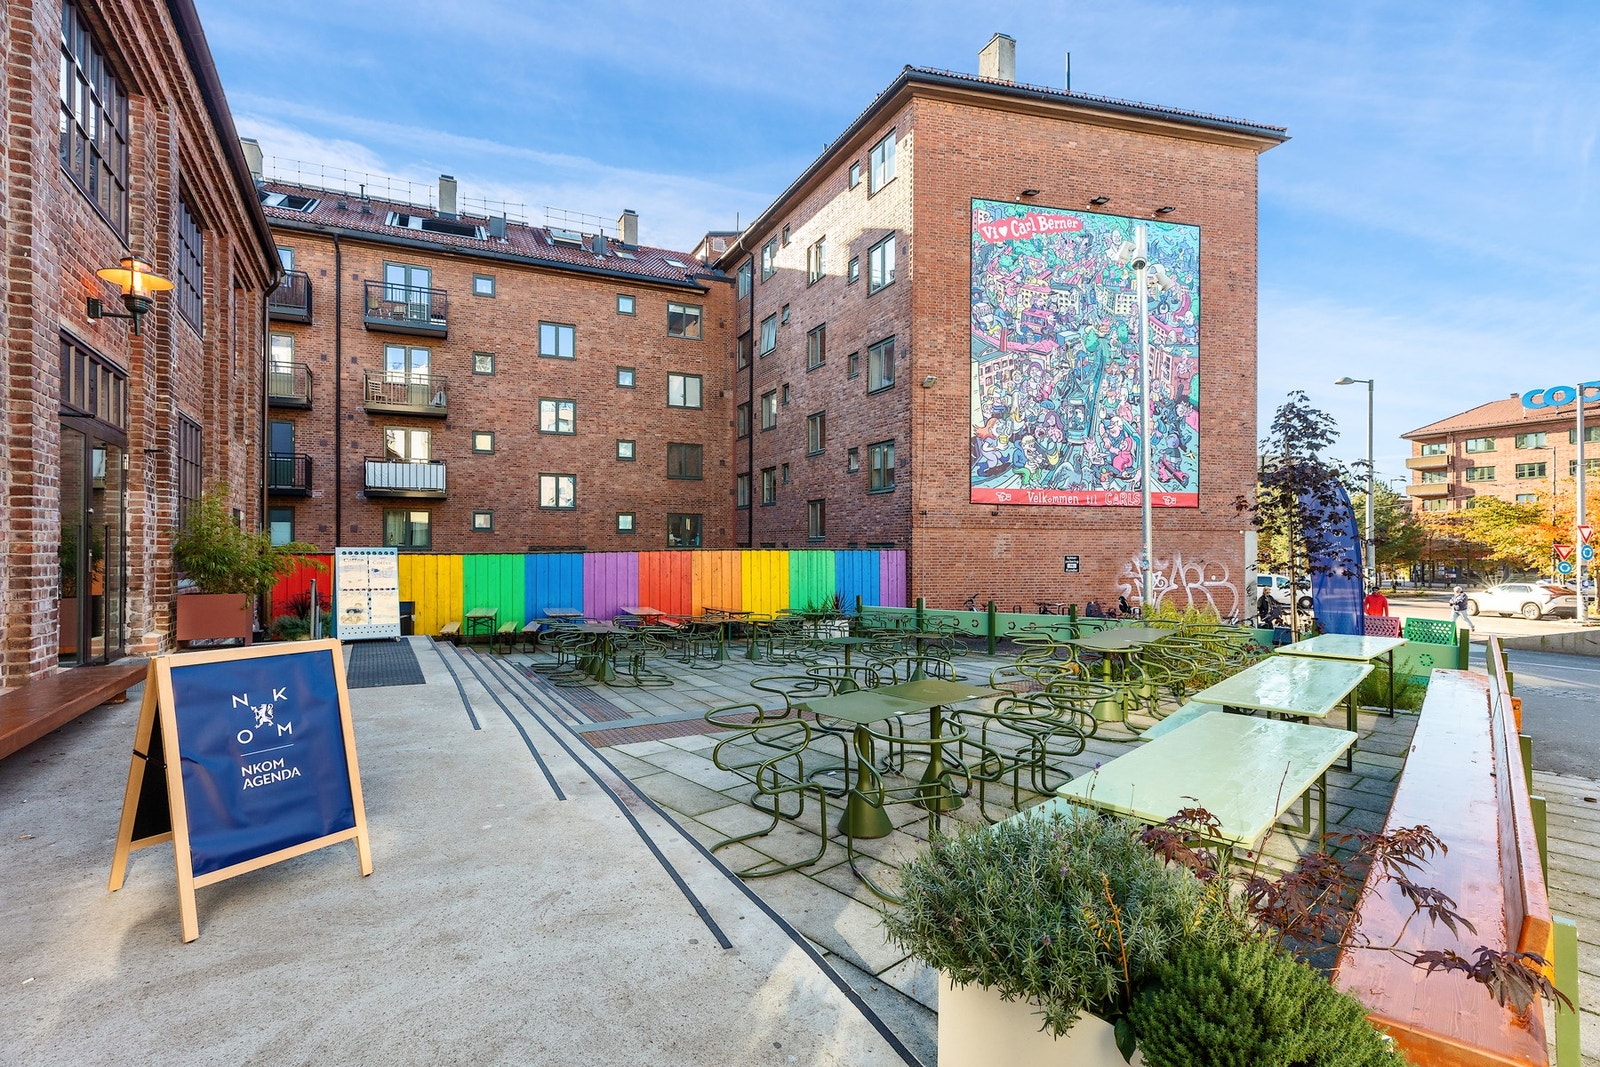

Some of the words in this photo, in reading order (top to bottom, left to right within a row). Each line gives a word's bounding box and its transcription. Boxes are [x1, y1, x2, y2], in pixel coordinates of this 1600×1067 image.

[981, 225, 999, 239] Vi
[1010, 217, 1037, 237] Carl
[1037, 215, 1079, 231] Berner
[1026, 491, 1080, 505] Velkommen
[1085, 494, 1098, 505] til
[1104, 492, 1141, 506] CARLS
[241, 757, 285, 777] NKOM
[243, 766, 301, 790] AGENDA
